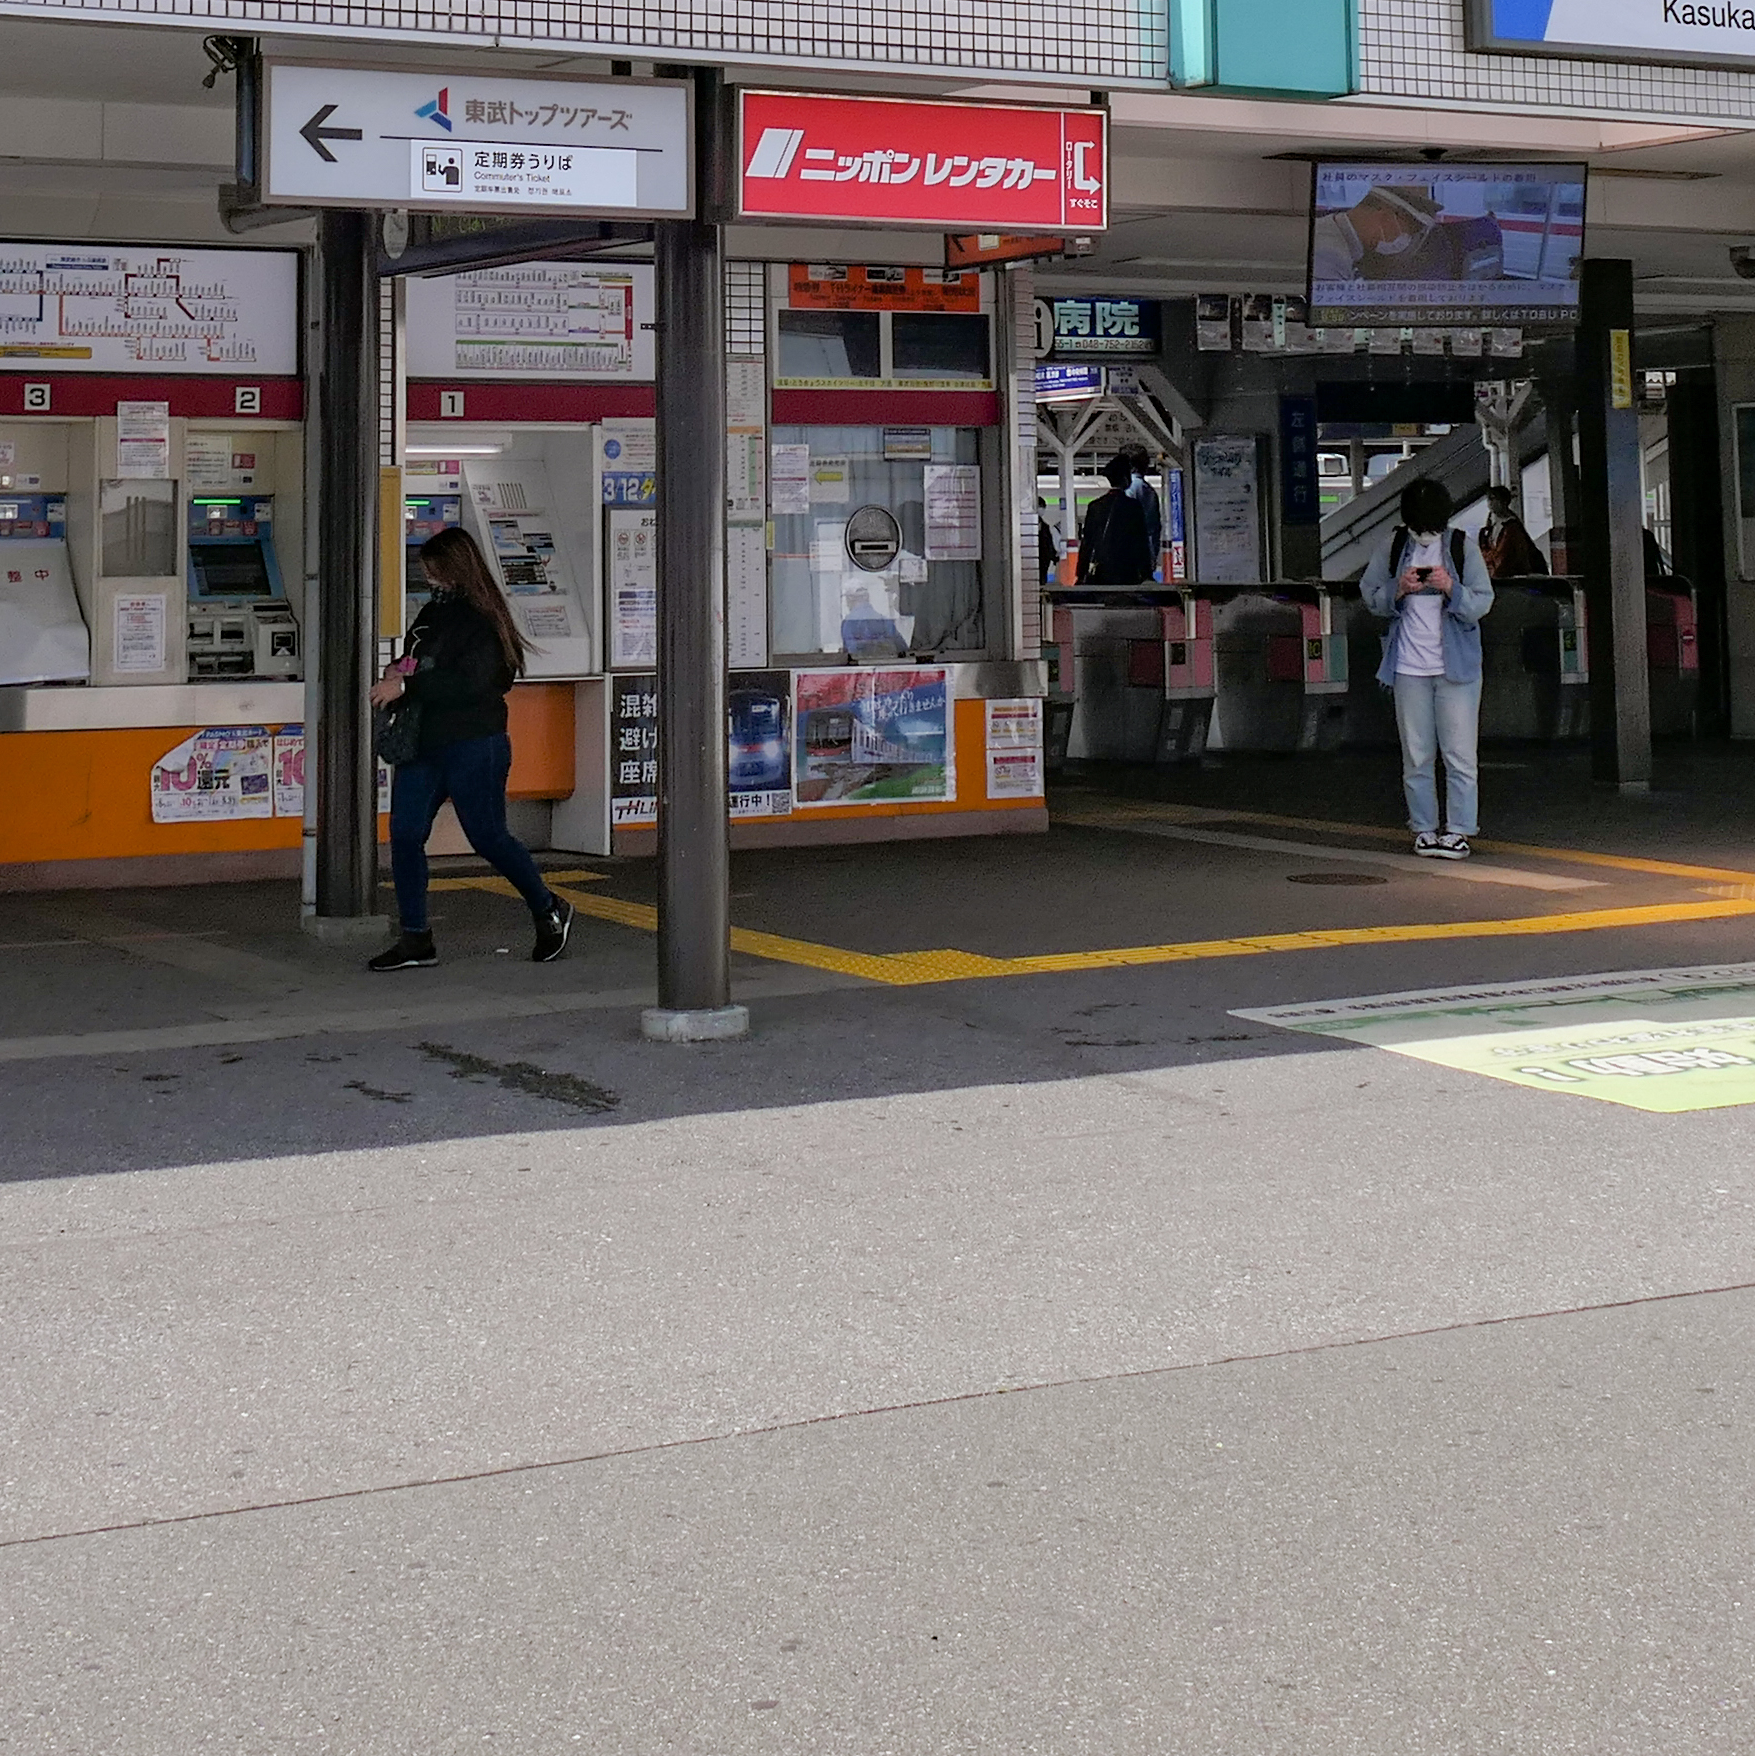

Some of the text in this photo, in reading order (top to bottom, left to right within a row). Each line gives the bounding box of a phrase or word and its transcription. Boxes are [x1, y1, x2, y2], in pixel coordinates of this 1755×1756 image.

[465, 99, 633, 131] 東武トップツアーズ
[474, 150, 573, 172] 定期券うりば
[800, 148, 1057, 191] ニッポンレンタカー
[1065, 141, 1073, 190] ロータリー
[474, 171, 550, 184] Commuter's Ticket
[1069, 199, 1099, 210] すぐそこ
[1054, 300, 1141, 336] 病院
[29, 387, 45, 406] 3
[240, 391, 256, 410] 2
[447, 394, 456, 414] 1
[614, 799, 657, 822] THLI
